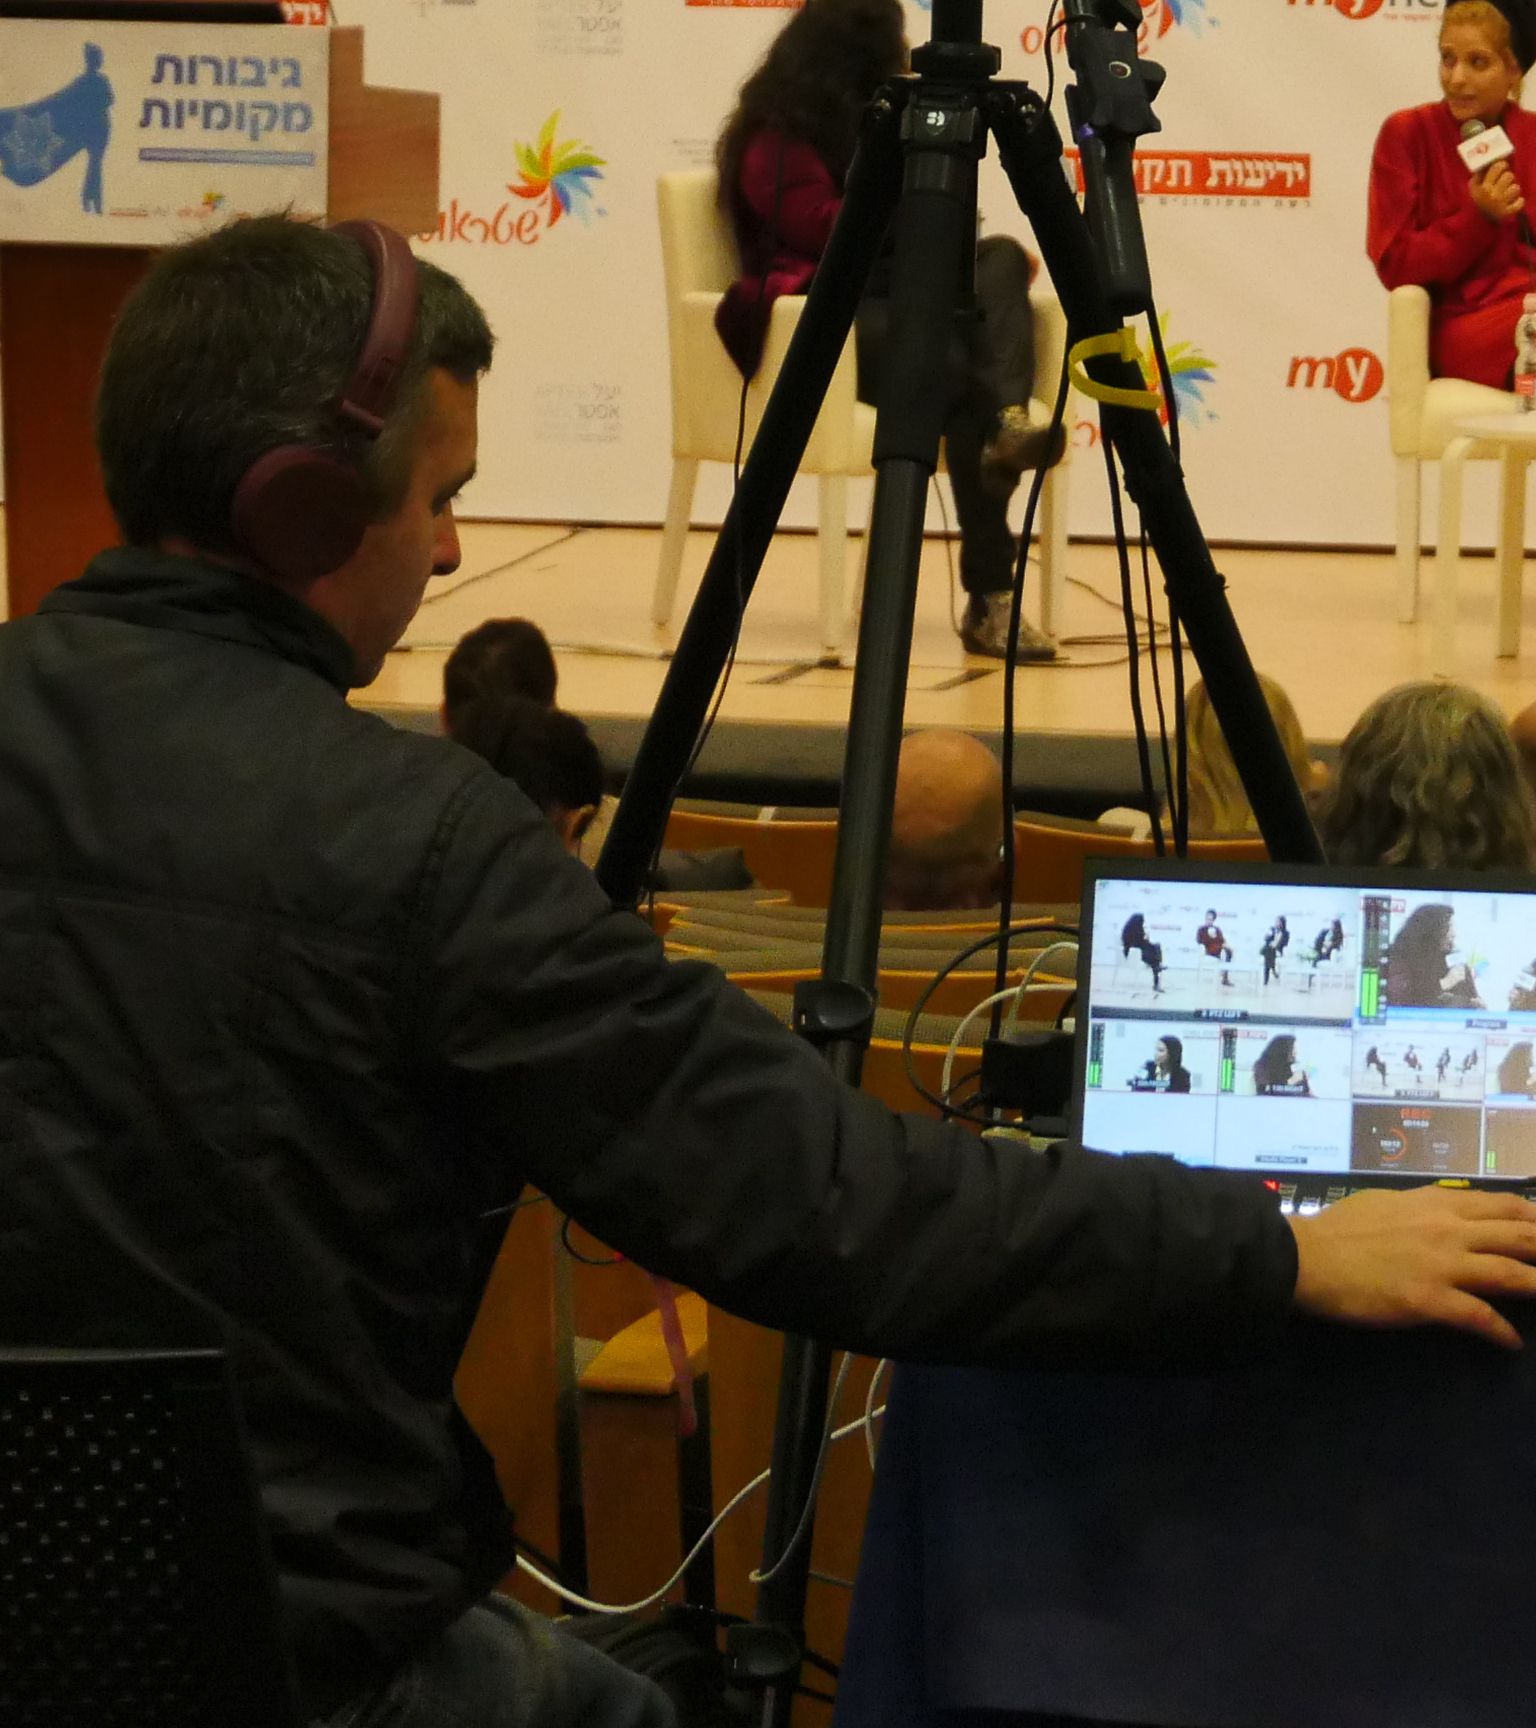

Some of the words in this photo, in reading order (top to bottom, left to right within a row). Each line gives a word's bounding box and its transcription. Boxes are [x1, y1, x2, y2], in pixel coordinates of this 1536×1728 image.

[151, 53, 302, 88] גיבורות
[139, 98, 313, 141] מקומיות
[1205, 157, 1307, 189] ידיעות
[419, 199, 539, 245] שטראו
